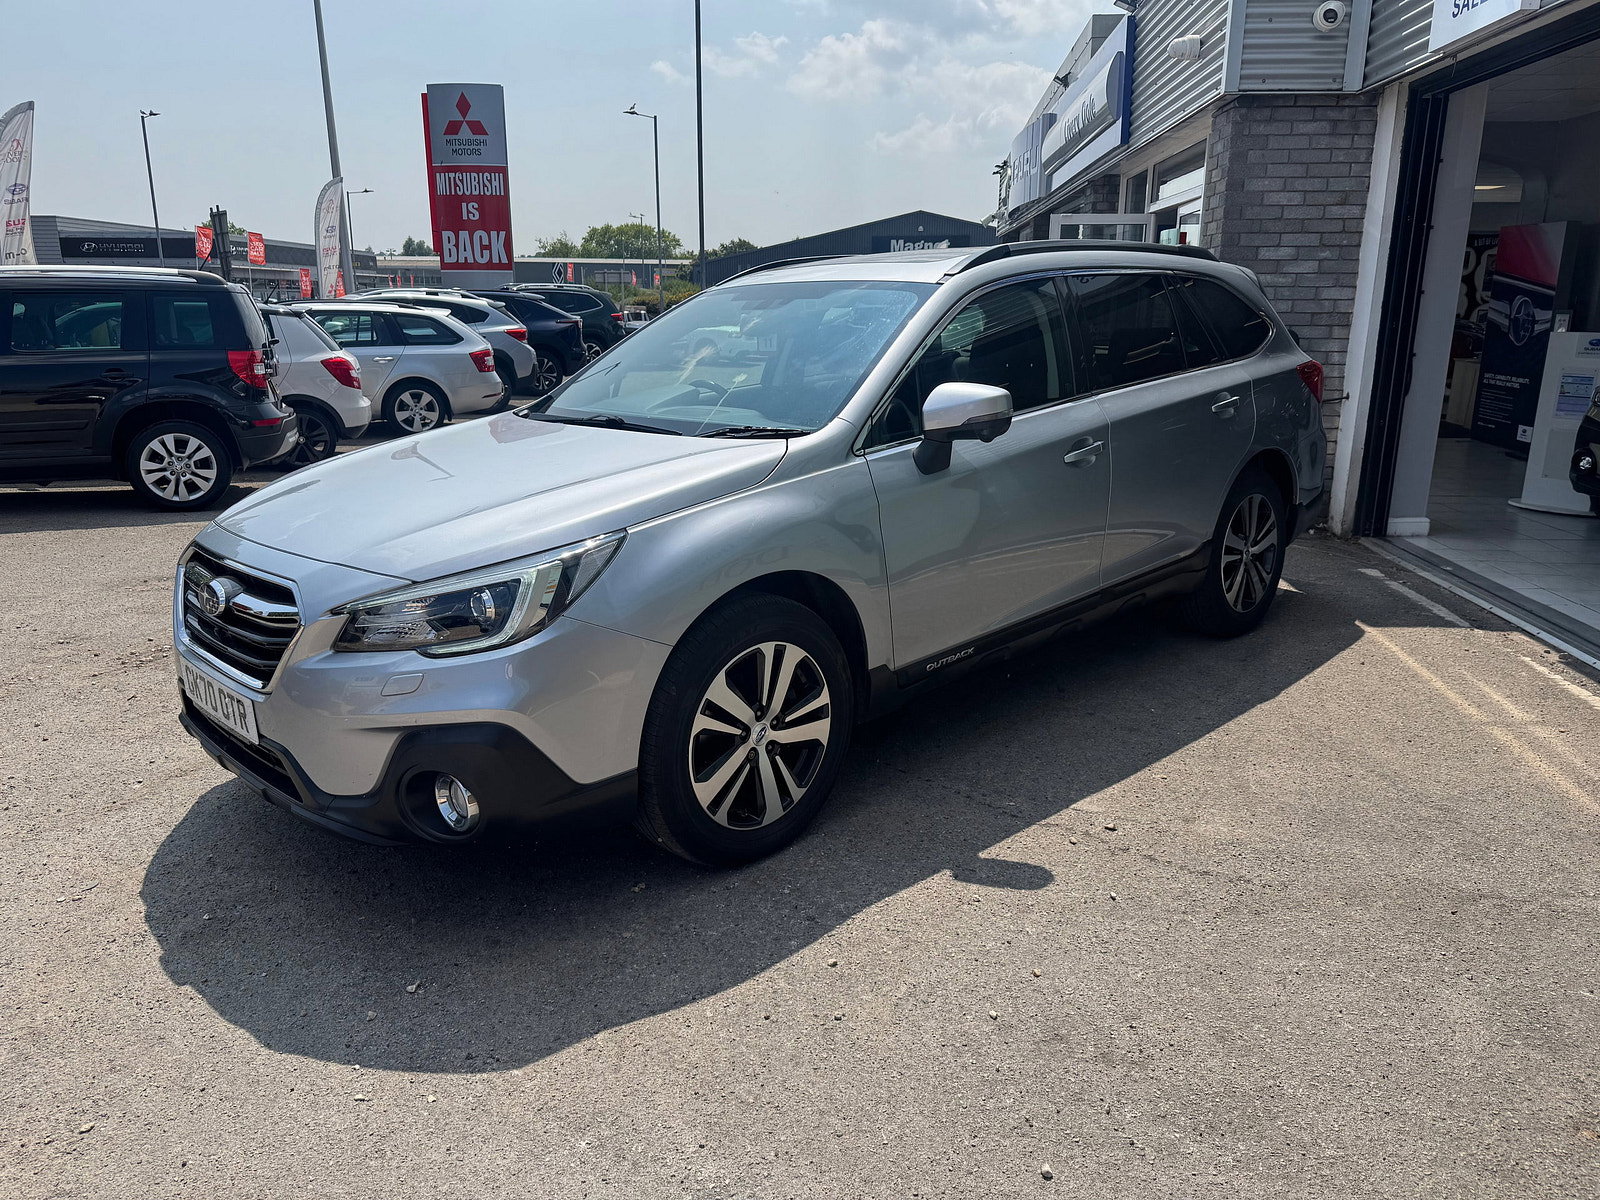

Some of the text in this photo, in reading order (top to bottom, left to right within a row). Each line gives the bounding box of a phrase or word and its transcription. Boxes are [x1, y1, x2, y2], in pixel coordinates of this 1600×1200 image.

[1452, 0, 1488, 18] SAL
[1081, 93, 1097, 128] Dole
[445, 138, 488, 147] MITSUBISHI
[451, 147, 482, 156] MOTORS
[435, 172, 504, 196] MITSUBISHI
[461, 202, 480, 221] IS
[441, 230, 509, 264] BACK
[926, 646, 975, 672] OUTBACK
